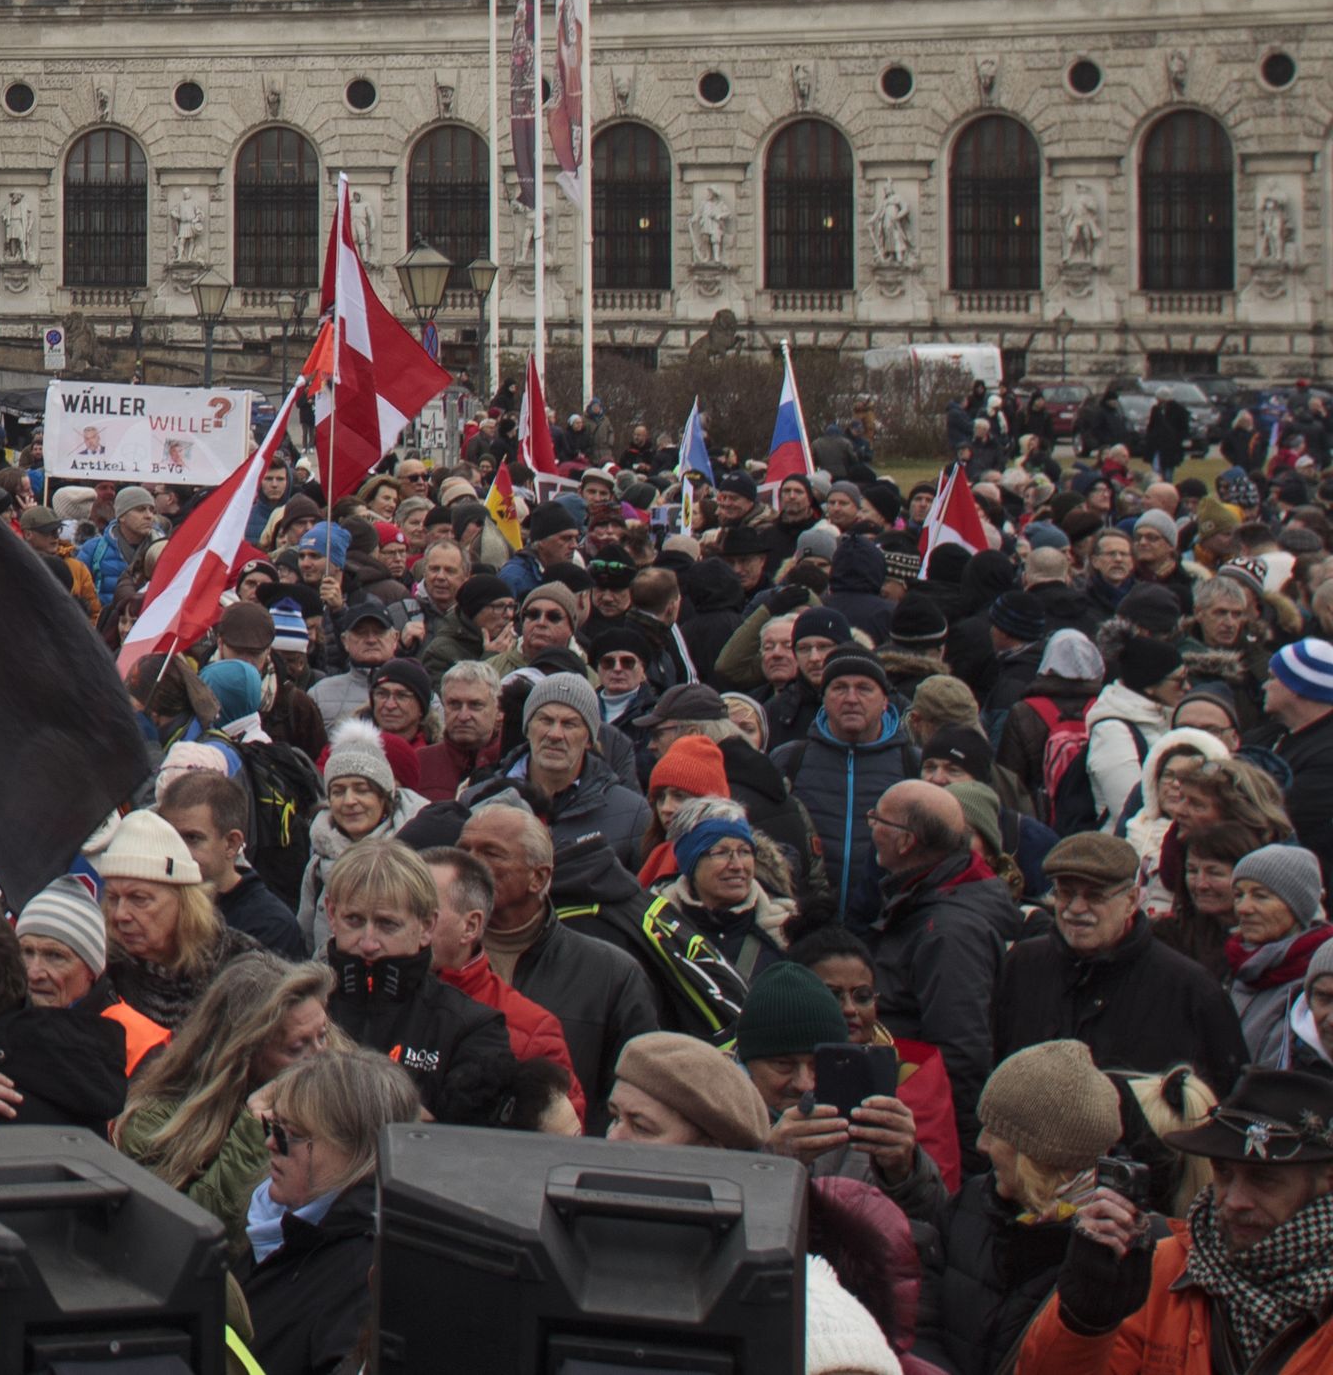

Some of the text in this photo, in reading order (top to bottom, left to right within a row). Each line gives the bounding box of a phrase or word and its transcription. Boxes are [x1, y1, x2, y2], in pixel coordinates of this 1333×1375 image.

[61, 387, 145, 416] WÄHLER
[70, 460, 127, 472] Artikel
[152, 463, 183, 474] B-VG
[406, 1046, 439, 1066] BOSS
